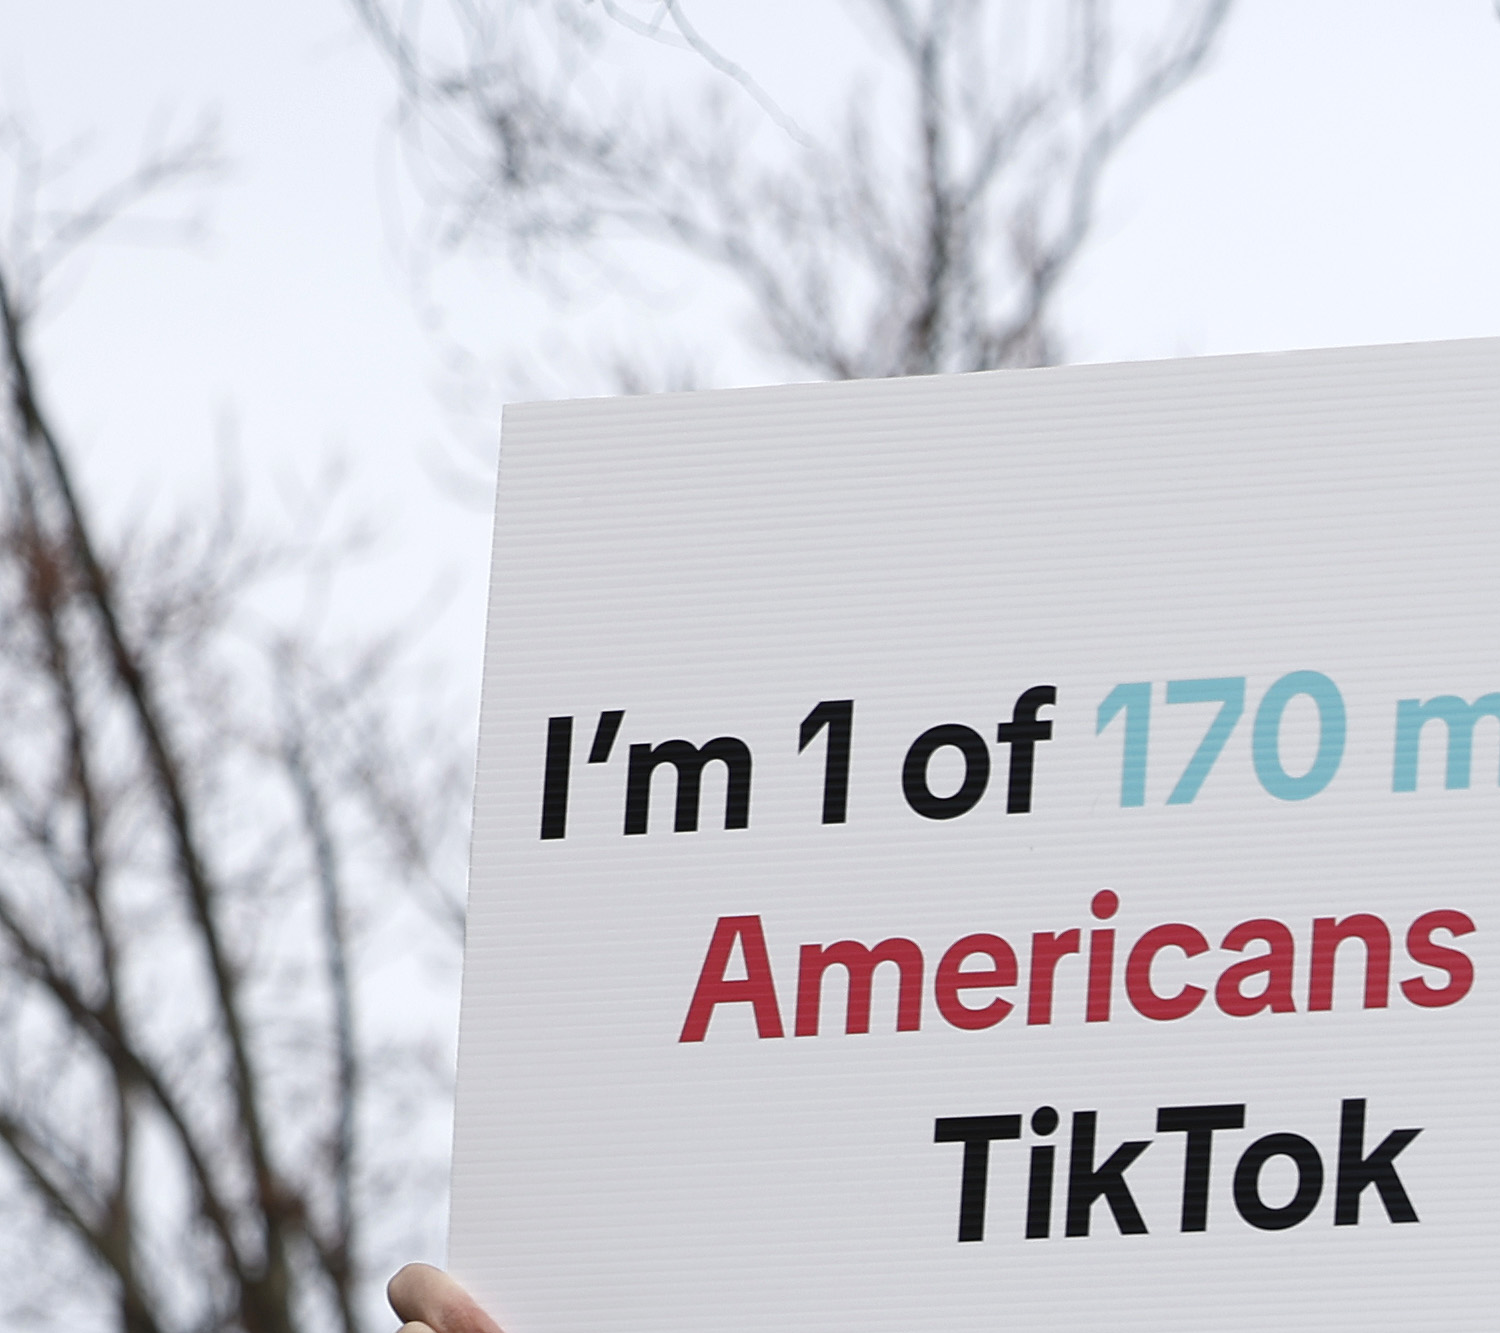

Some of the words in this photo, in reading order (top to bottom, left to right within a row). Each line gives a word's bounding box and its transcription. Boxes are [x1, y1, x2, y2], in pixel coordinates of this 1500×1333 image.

[540, 710, 752, 840] I'm
[798, 699, 854, 824] 1
[901, 685, 1057, 820] of
[1096, 670, 1346, 807] 170
[678, 889, 1476, 1043] Americans
[933, 1098, 1424, 1243] TikTok
